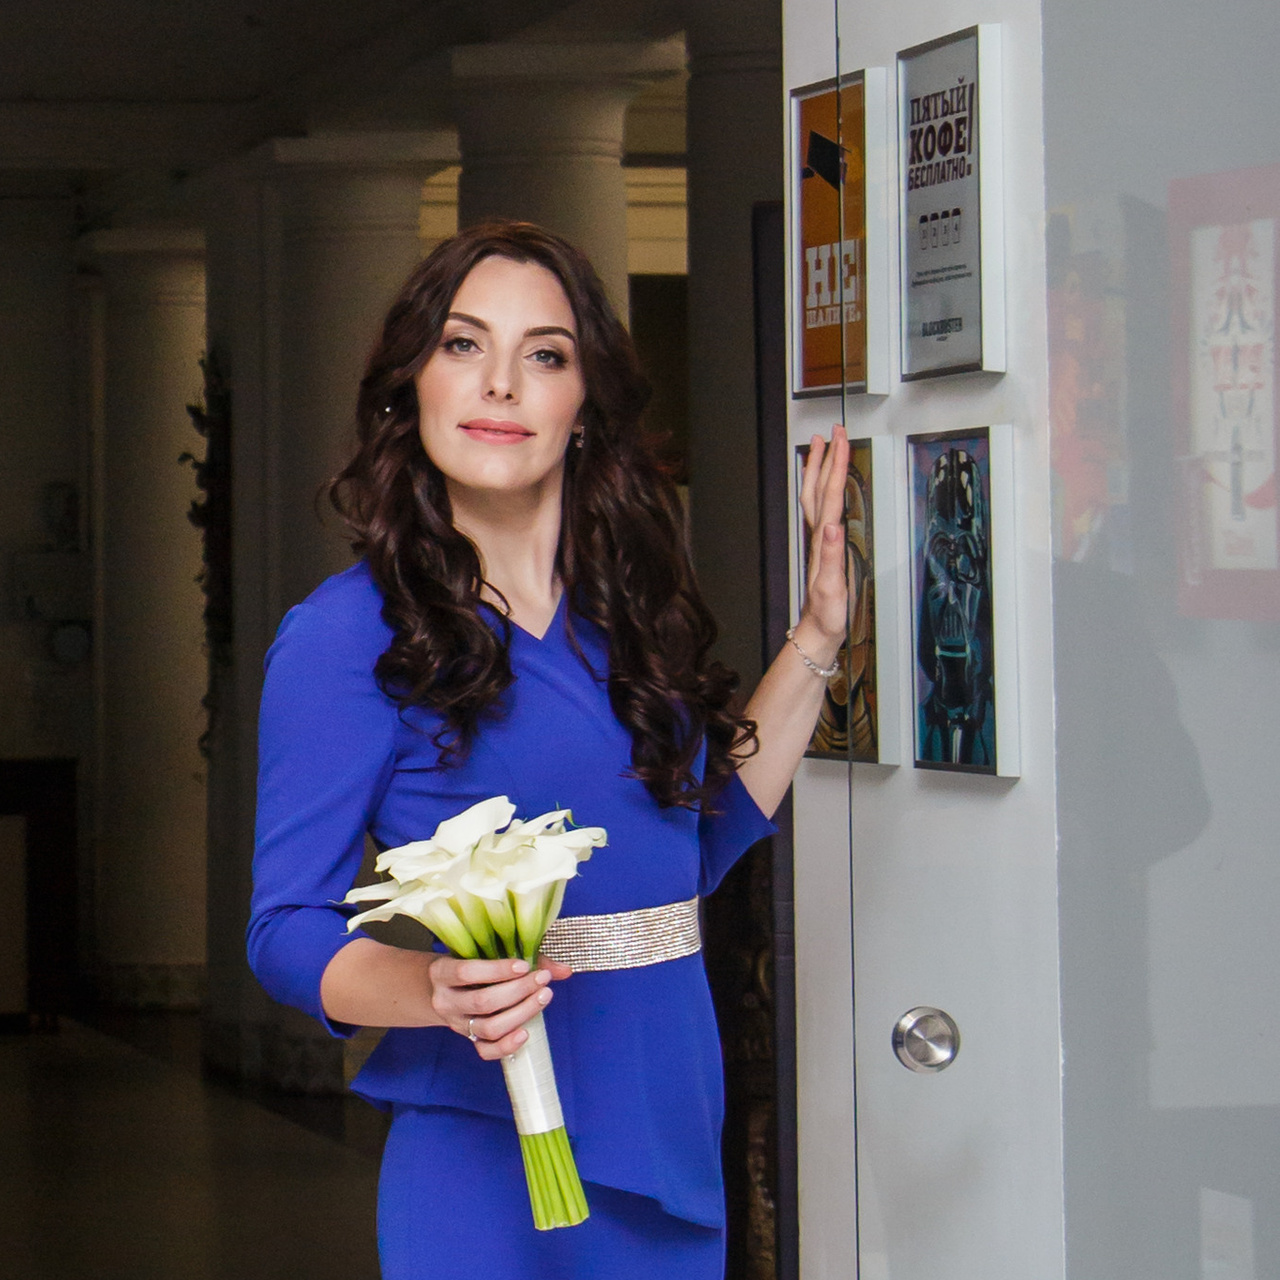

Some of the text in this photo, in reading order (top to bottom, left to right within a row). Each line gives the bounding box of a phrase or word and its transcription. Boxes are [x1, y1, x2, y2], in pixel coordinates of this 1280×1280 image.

[910, 76, 968, 126] ПЯТЫЙ
[909, 116, 968, 165] КОФЕ
[805, 239, 856, 308] НЕ
